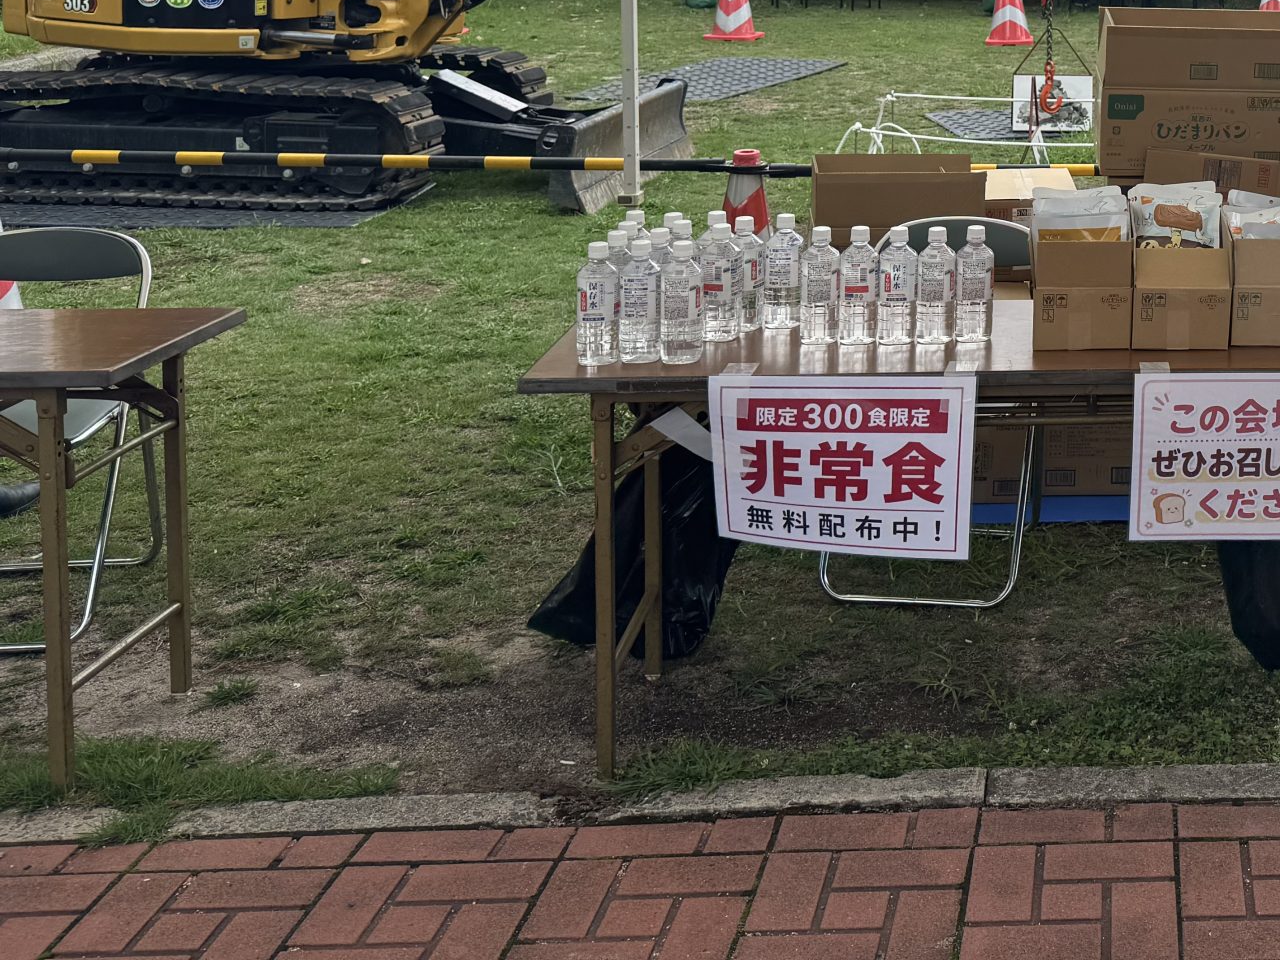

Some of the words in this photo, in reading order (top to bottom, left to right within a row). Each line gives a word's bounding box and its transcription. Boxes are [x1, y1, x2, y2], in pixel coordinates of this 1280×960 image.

[1156, 123, 1248, 141] ひだまりパン
[755, 403, 931, 430] 限定300食限定
[740, 439, 946, 505] 非常食
[746, 504, 942, 543] 無料配布中！
